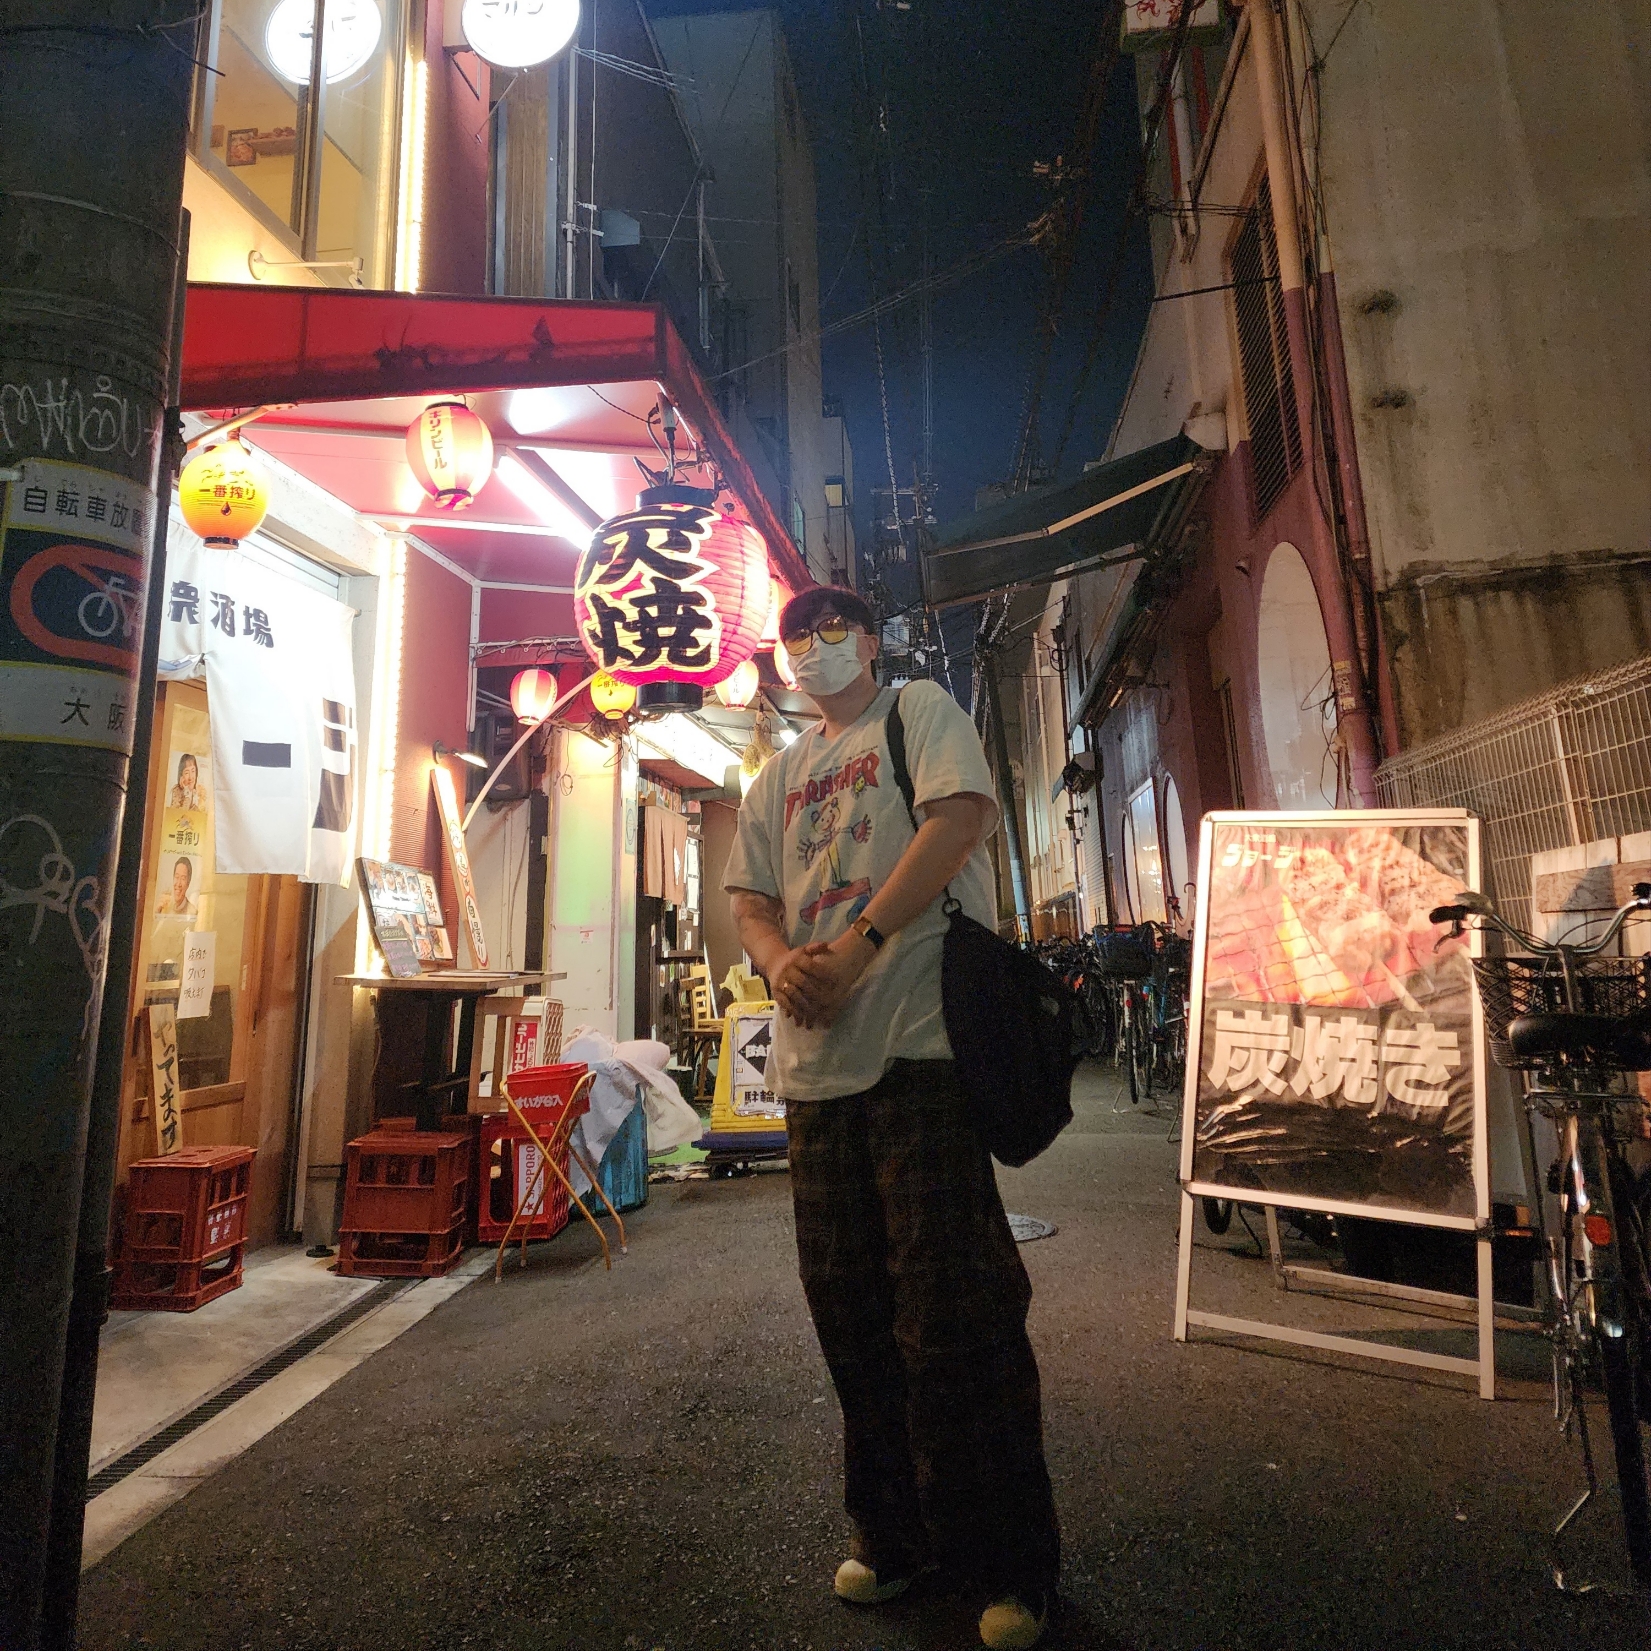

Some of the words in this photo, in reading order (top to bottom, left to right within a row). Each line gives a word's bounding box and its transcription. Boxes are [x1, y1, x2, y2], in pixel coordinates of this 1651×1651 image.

[428, 409, 448, 470] キリンビール
[198, 484, 256, 501] 一番搾り
[578, 505, 716, 667] 炭焼
[168, 830, 200, 847] 一番搾り
[1207, 1010, 1461, 1107] 炭焼き
